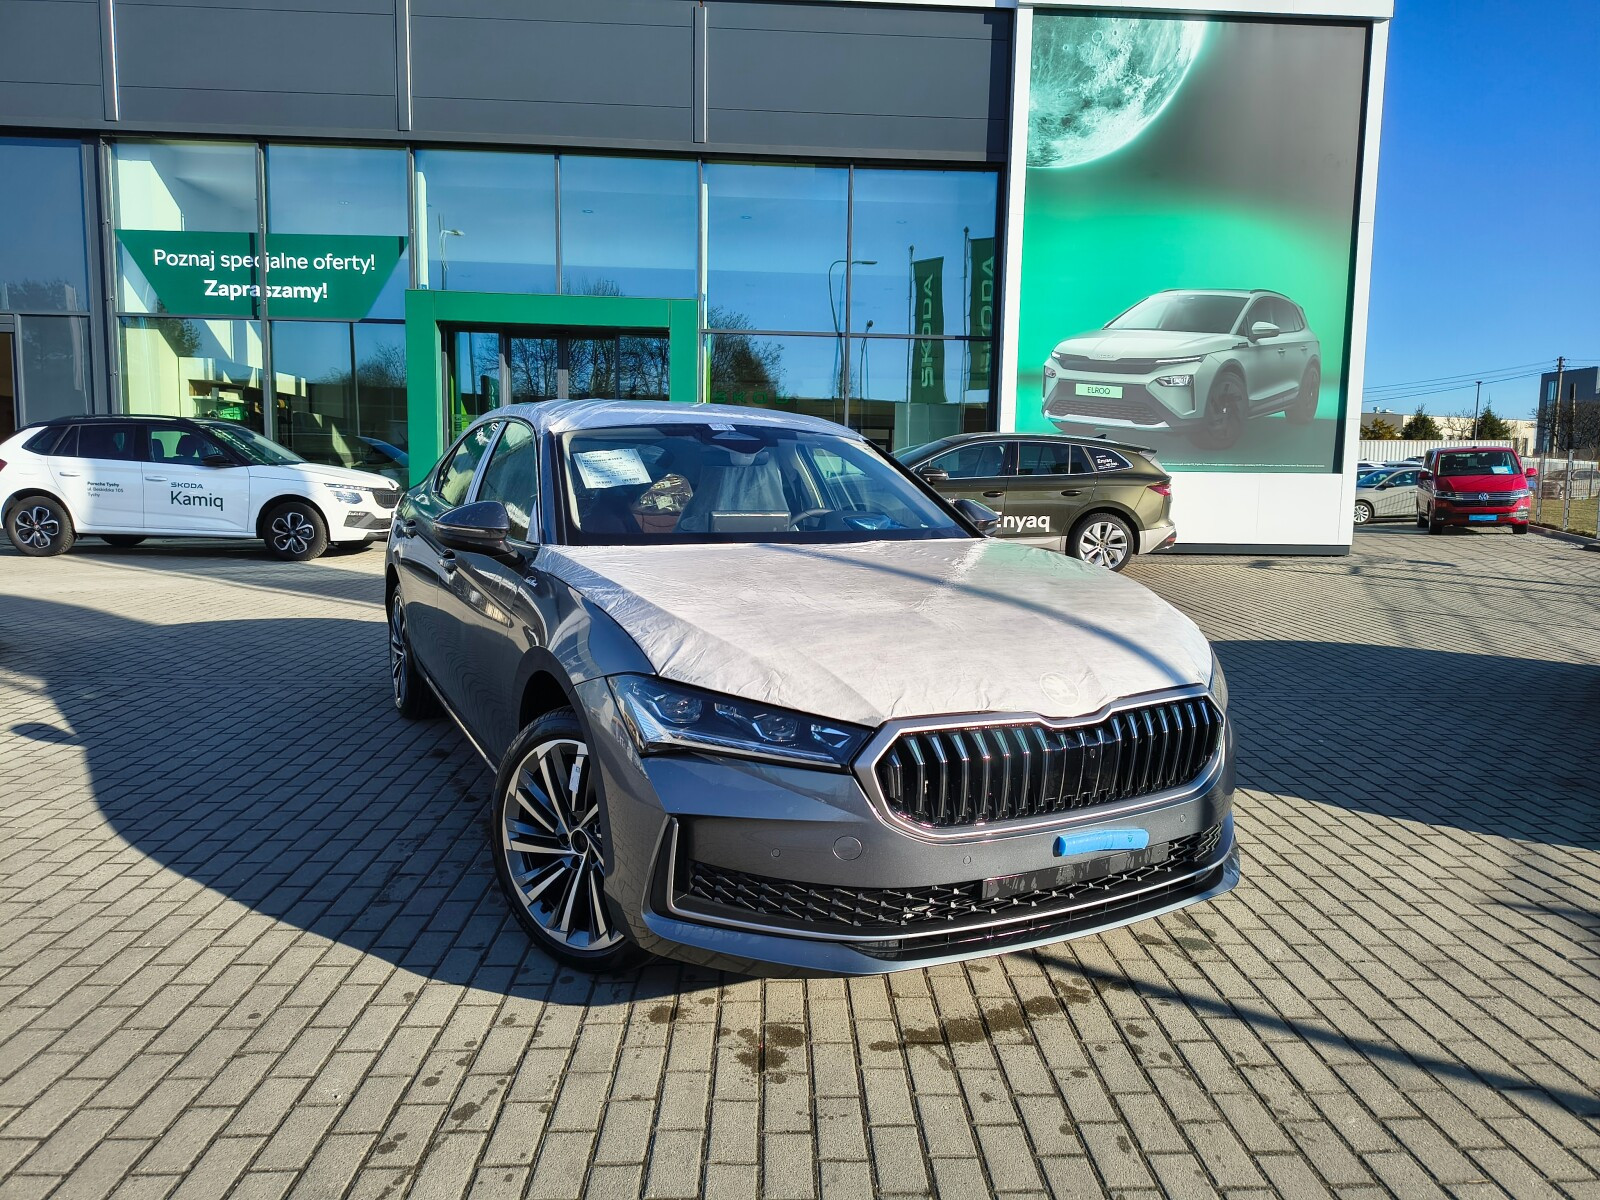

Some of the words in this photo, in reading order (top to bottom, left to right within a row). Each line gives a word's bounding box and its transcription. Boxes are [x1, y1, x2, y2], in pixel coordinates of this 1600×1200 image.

[154, 249, 215, 271] Poznaj
[313, 253, 376, 275] oferty!
[203, 279, 328, 303] Zapraszamy!
[980, 255, 995, 373] ODA
[170, 490, 224, 512] Kamiq
